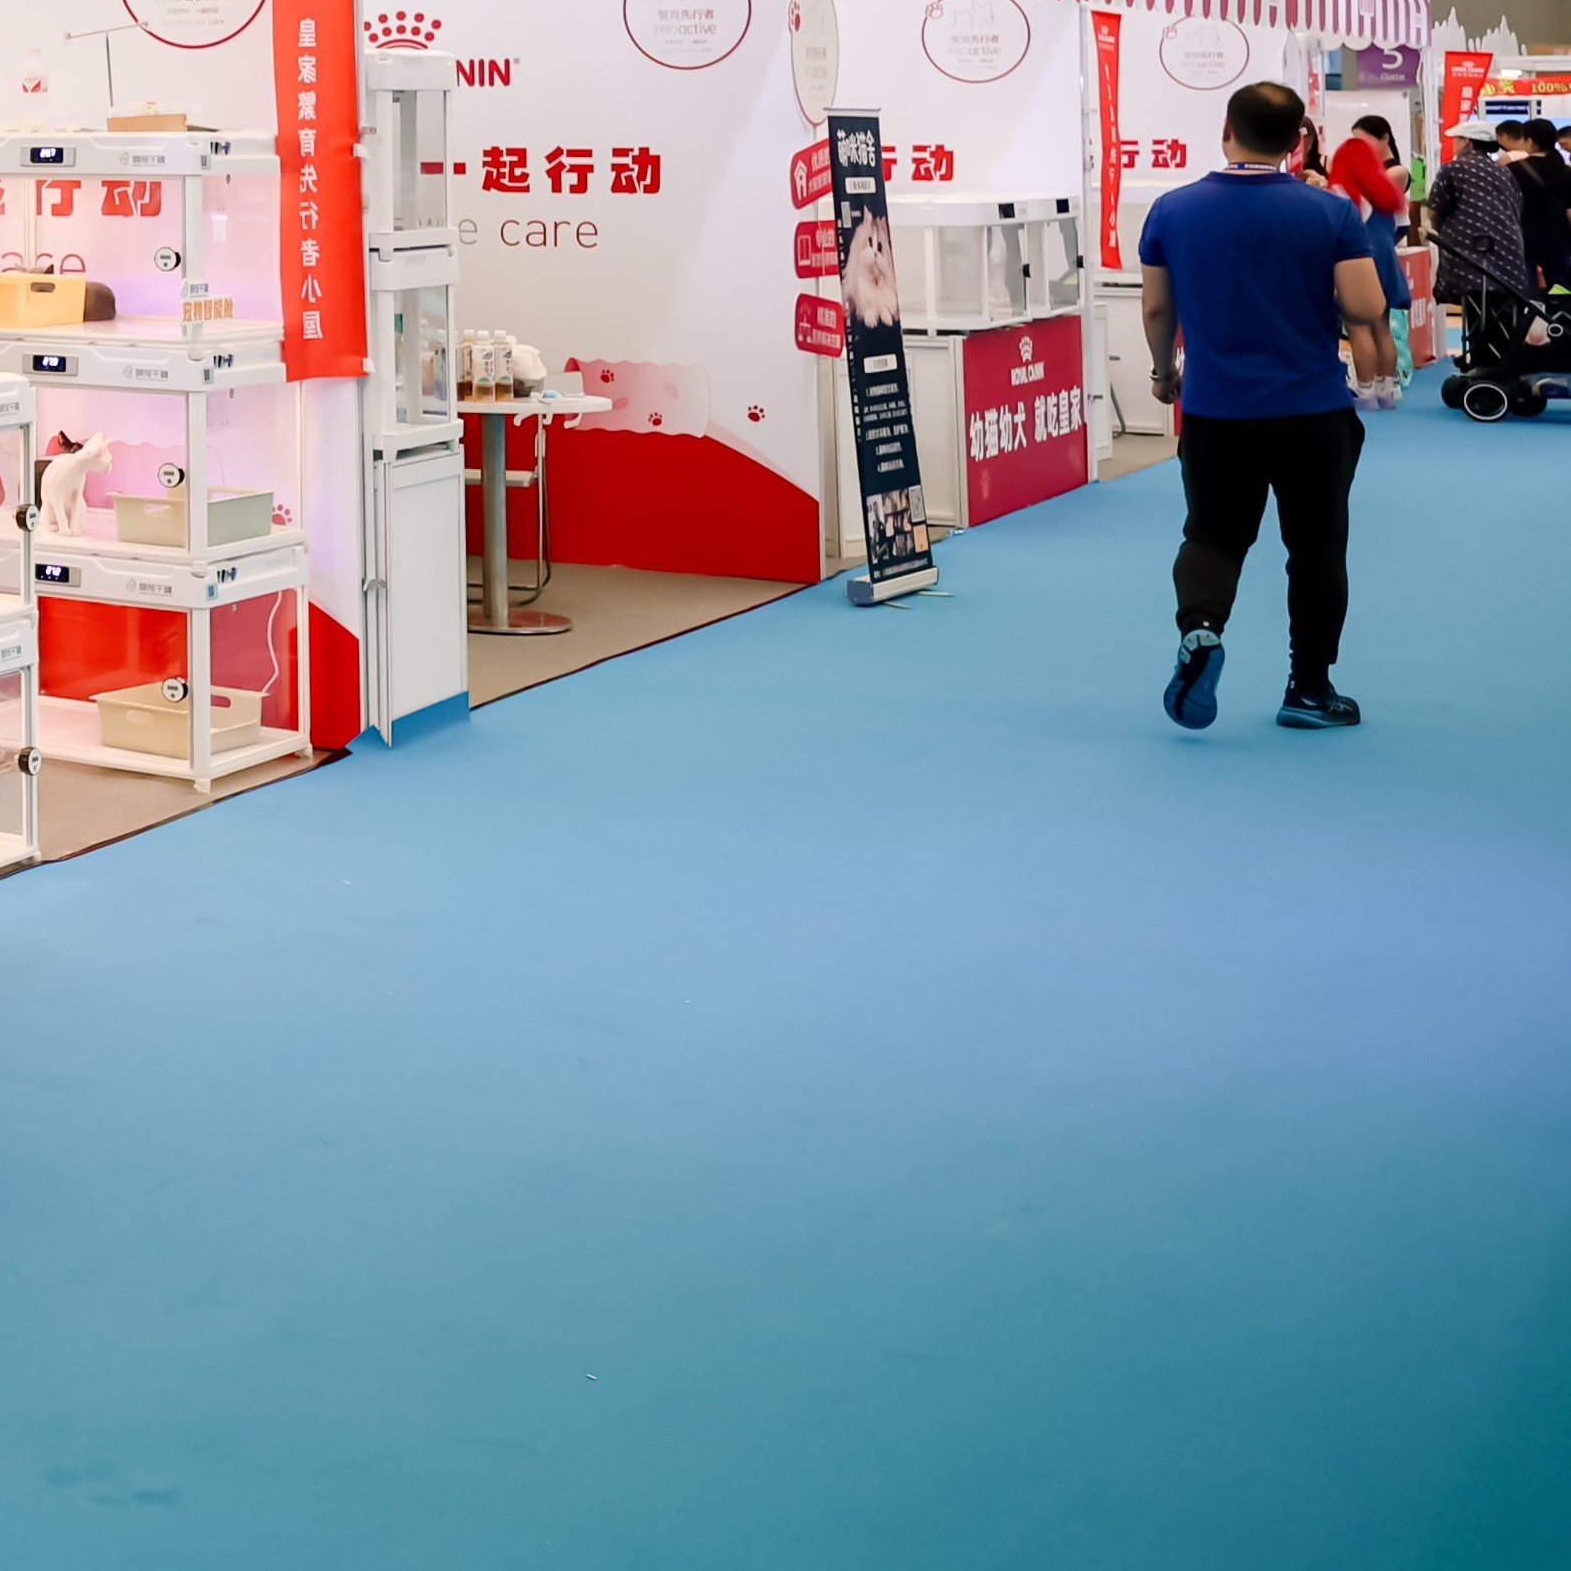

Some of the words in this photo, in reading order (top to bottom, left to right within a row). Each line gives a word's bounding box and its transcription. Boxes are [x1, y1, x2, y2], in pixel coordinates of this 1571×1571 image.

[455, 58, 511, 87] NIN
[499, 216, 599, 248] care
[969, 401, 1027, 463] 幼猫幼犬
[1034, 385, 1082, 444] 就吃皇家
